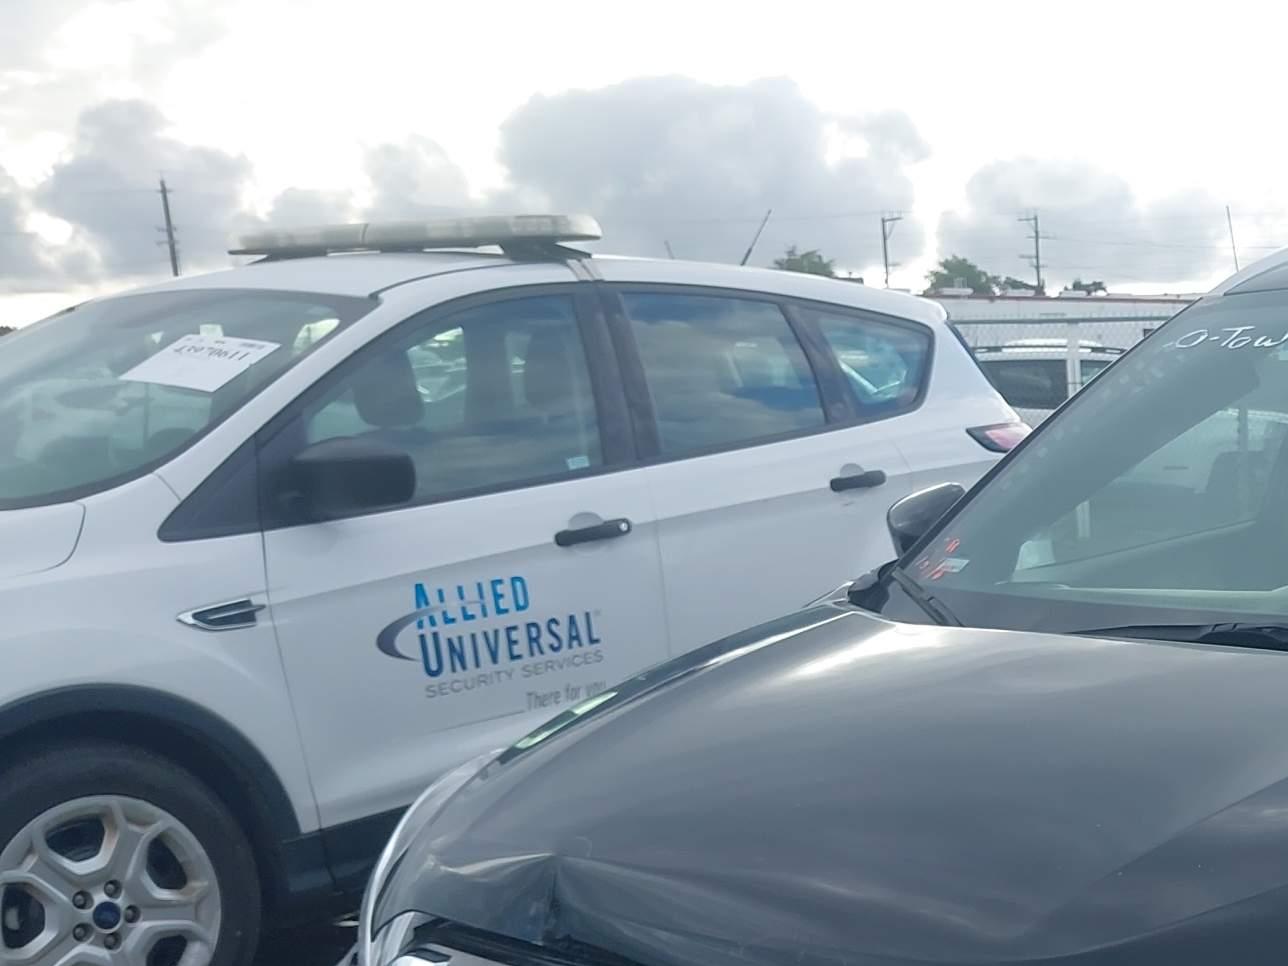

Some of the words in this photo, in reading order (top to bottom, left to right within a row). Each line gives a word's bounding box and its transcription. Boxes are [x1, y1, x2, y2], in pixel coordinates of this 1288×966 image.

[414, 576, 530, 630] ALLIED
[419, 611, 601, 677] UNIVERSAL
[425, 669, 514, 698] SECURITY
[522, 650, 604, 678] SERVICES
[526, 690, 561, 711] There
[565, 683, 582, 702] for
